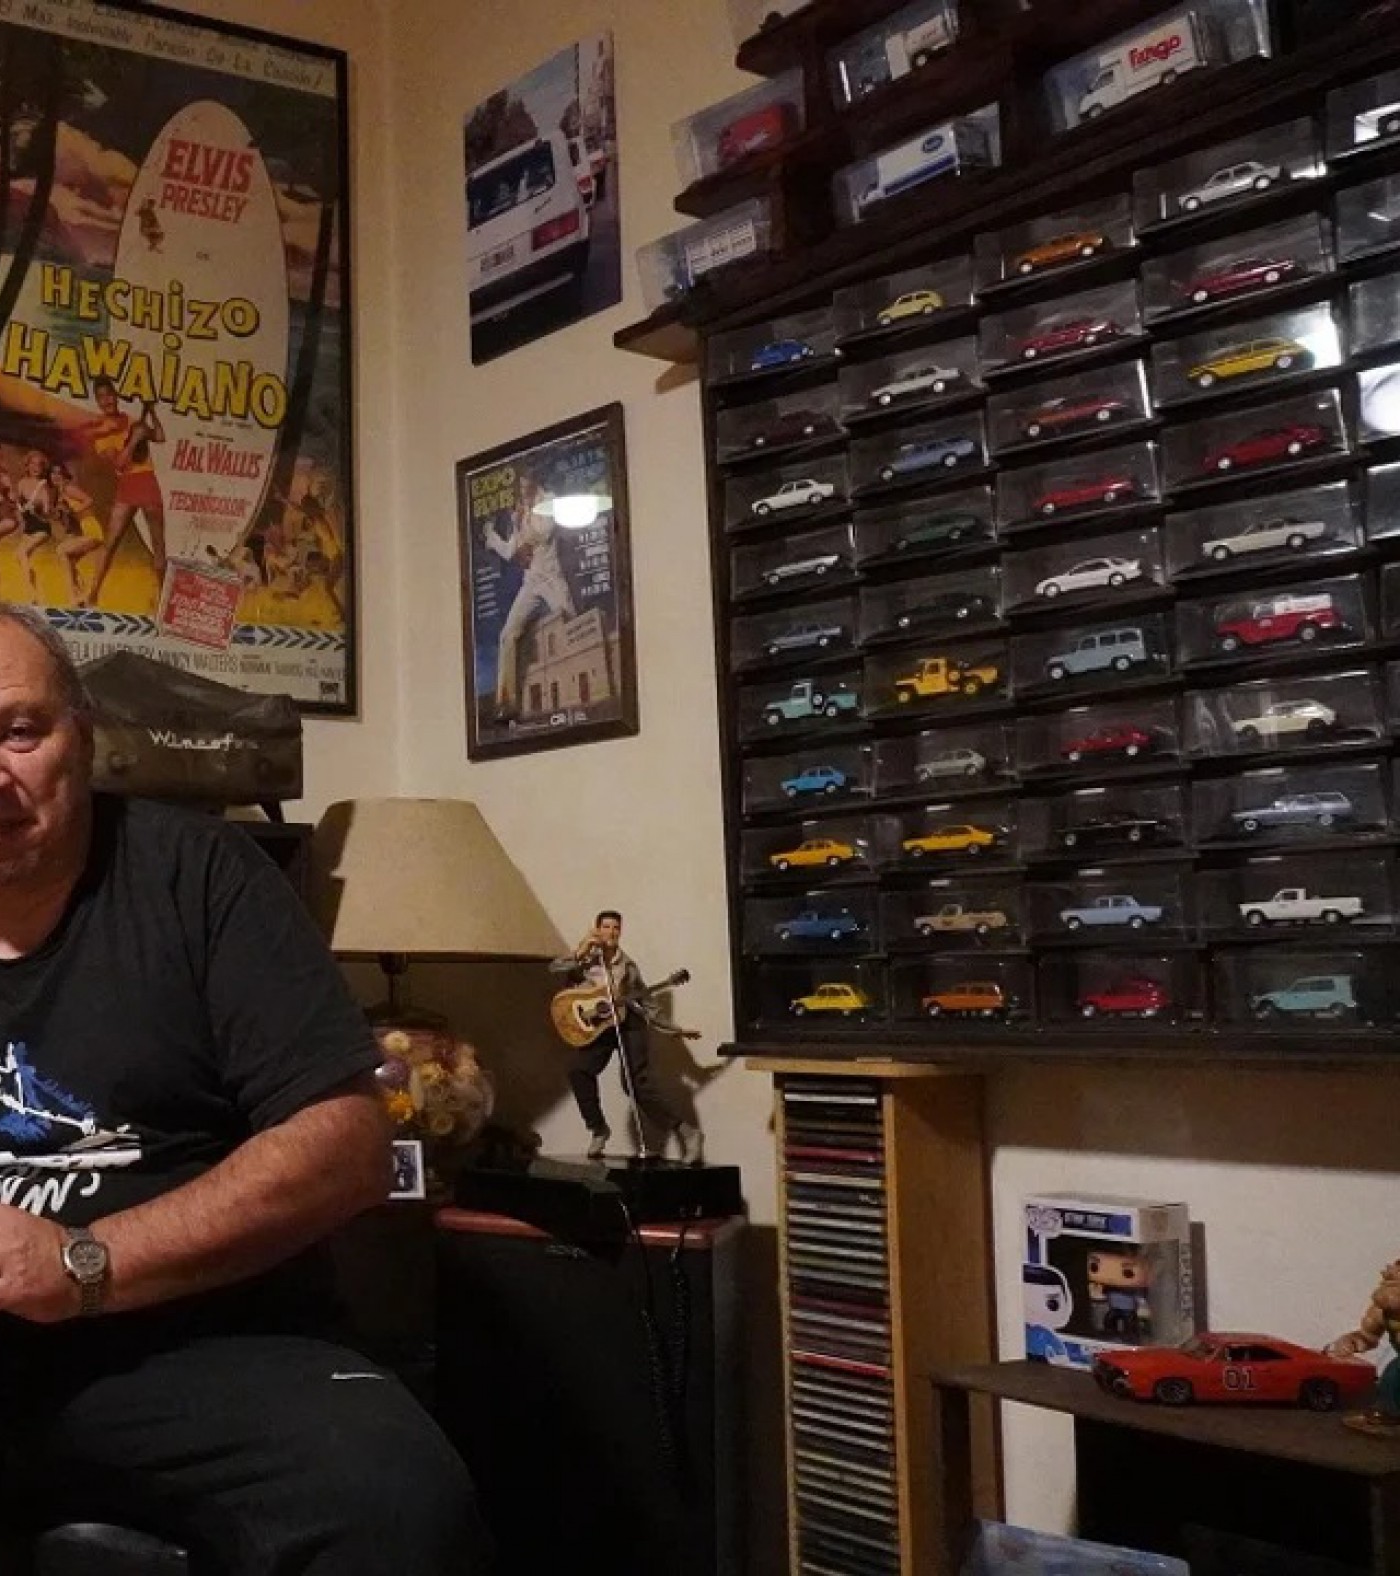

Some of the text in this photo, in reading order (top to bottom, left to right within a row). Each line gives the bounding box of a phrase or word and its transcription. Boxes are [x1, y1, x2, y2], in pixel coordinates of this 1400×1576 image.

[161, 139, 256, 194] ELVIS
[159, 183, 248, 225] PRESLEY
[1222, 1365, 1259, 1391] 01
